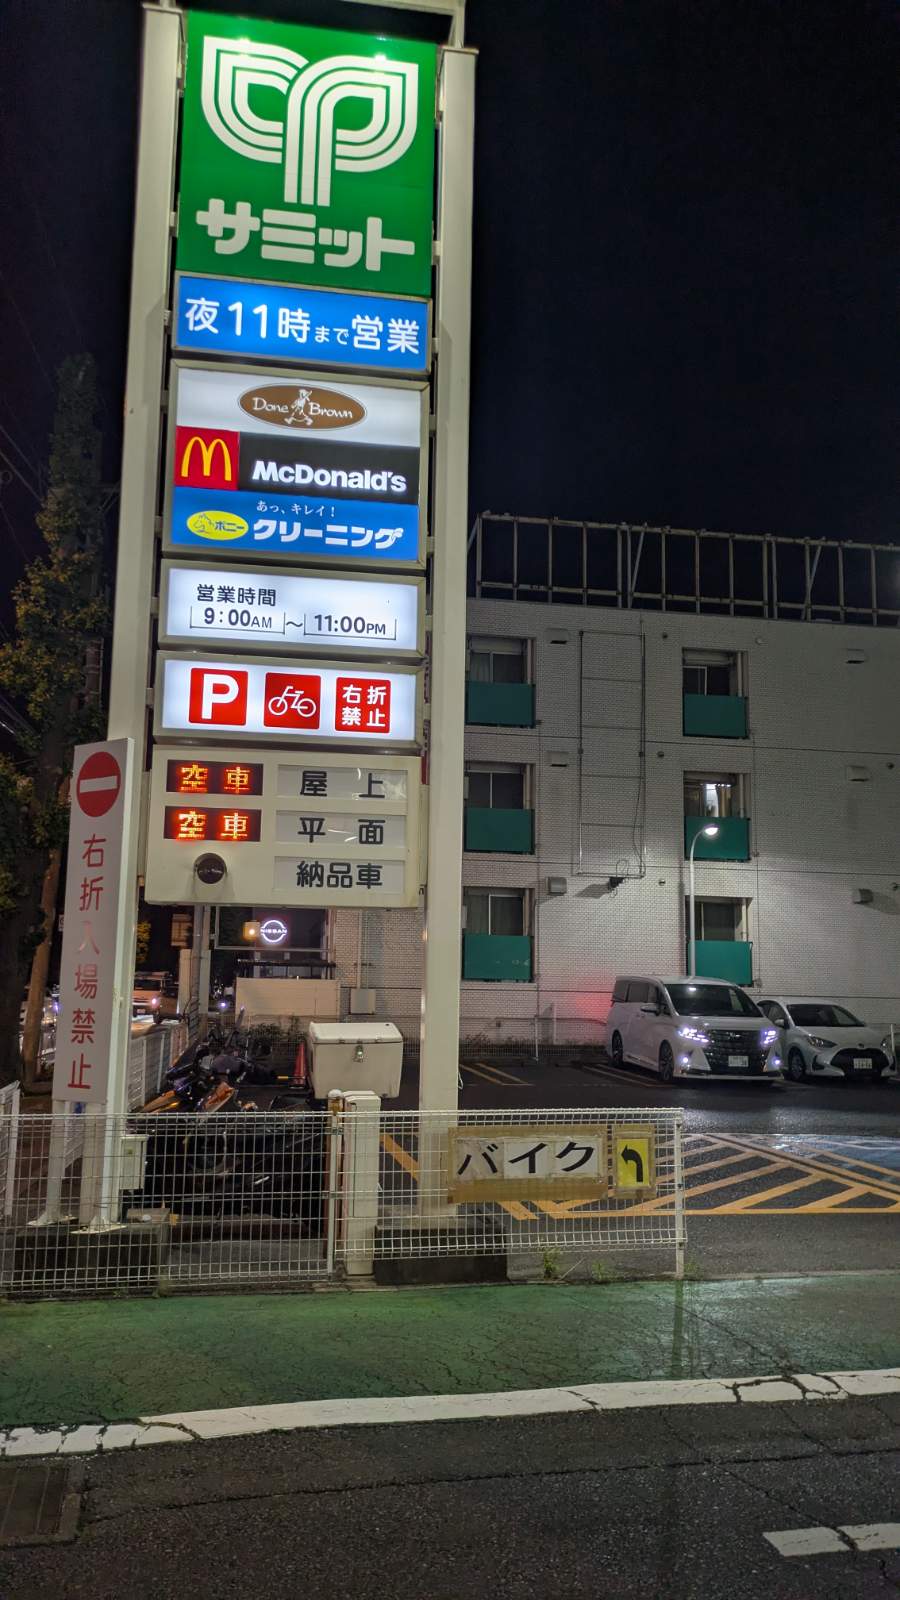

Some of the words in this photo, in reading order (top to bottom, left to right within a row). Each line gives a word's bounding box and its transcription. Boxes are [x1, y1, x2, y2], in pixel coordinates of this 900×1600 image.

[196, 198, 415, 271] サミット
[185, 297, 419, 354] 夜11時まで営業
[252, 397, 289, 412] Done
[308, 402, 352, 418] Brown
[252, 460, 407, 492] McDonald's
[253, 519, 404, 549] クリーニング
[197, 584, 276, 606] 営業時間
[202, 674, 239, 719] P
[342, 685, 387, 706] 右折
[341, 706, 386, 727] 禁止
[180, 765, 250, 793] 空車
[300, 770, 385, 798] 屋上
[178, 811, 248, 839] 空車
[298, 817, 385, 844] 平面
[296, 861, 383, 889] 納品車
[67, 833, 107, 1090] 右折入場禁止
[458, 1142, 594, 1175] バイク
